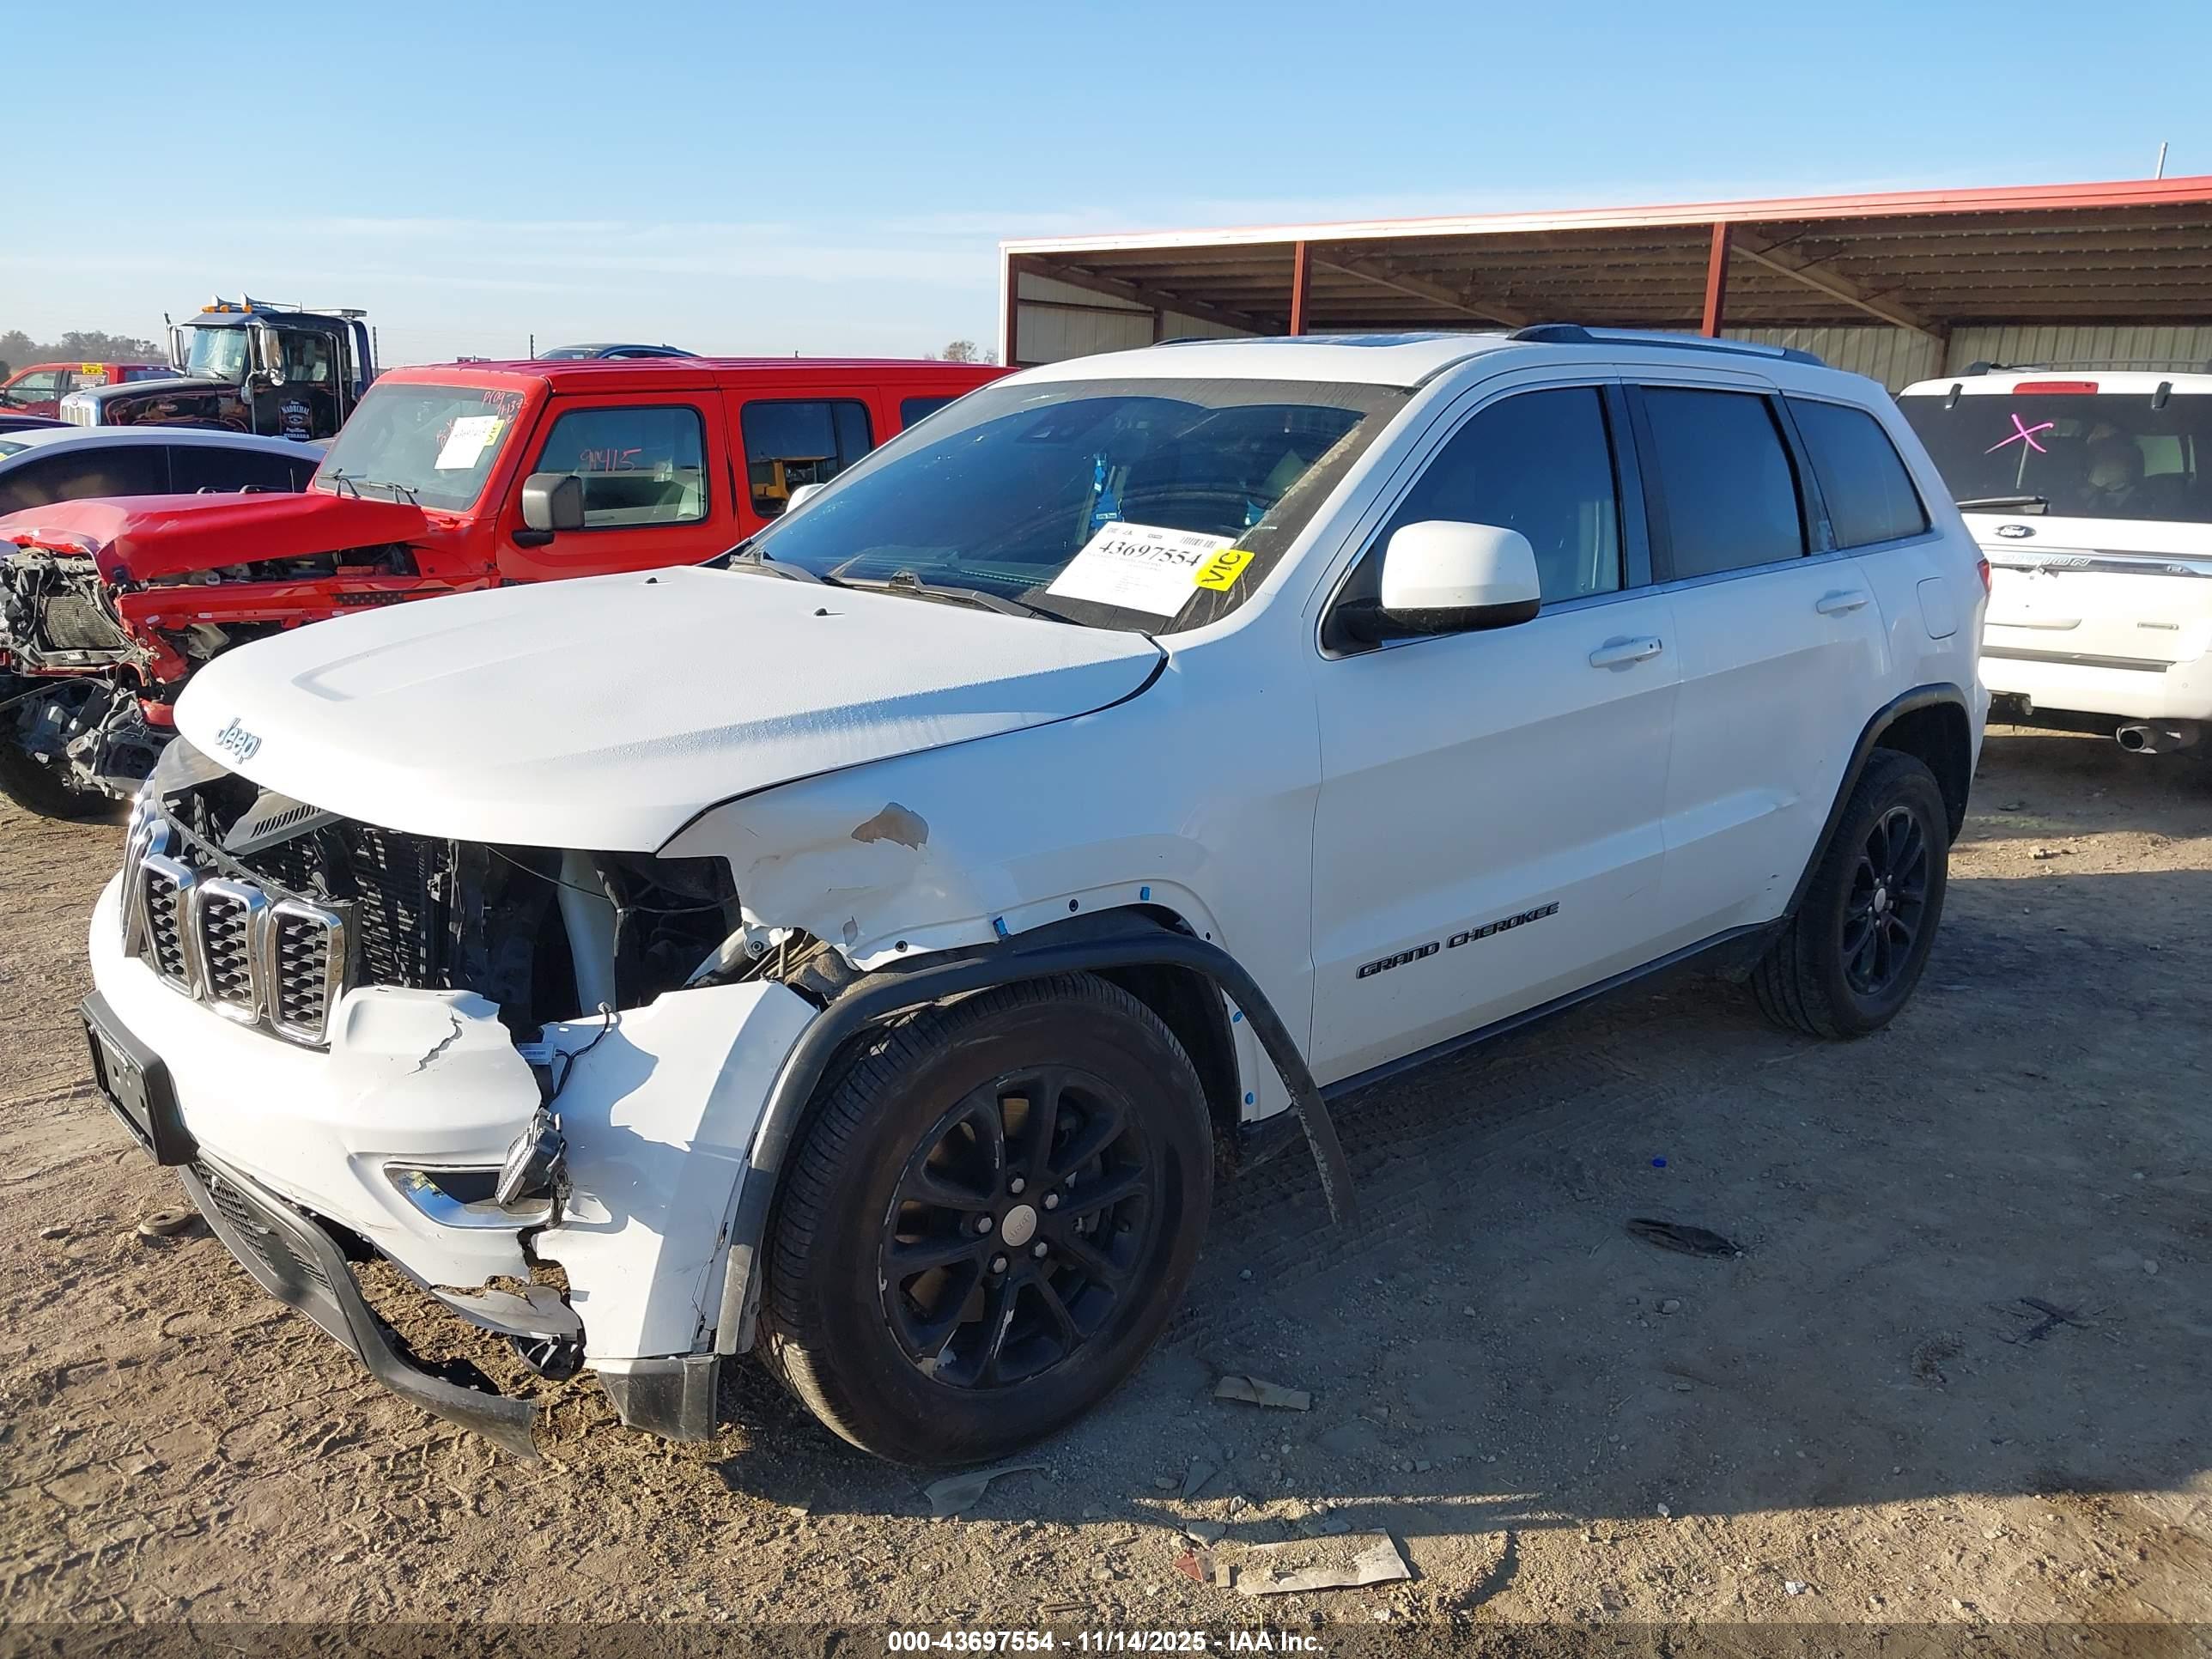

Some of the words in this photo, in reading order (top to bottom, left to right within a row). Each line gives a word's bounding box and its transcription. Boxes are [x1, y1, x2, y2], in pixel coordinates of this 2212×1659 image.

[2000, 526, 2027, 537] Ford
[1098, 540, 1203, 567] 43697554
[1201, 551, 1242, 584] VIC
[215, 717, 262, 765] Jeep
[1356, 940, 1441, 980] GRAND
[1446, 901, 1560, 949] CHEROKEE
